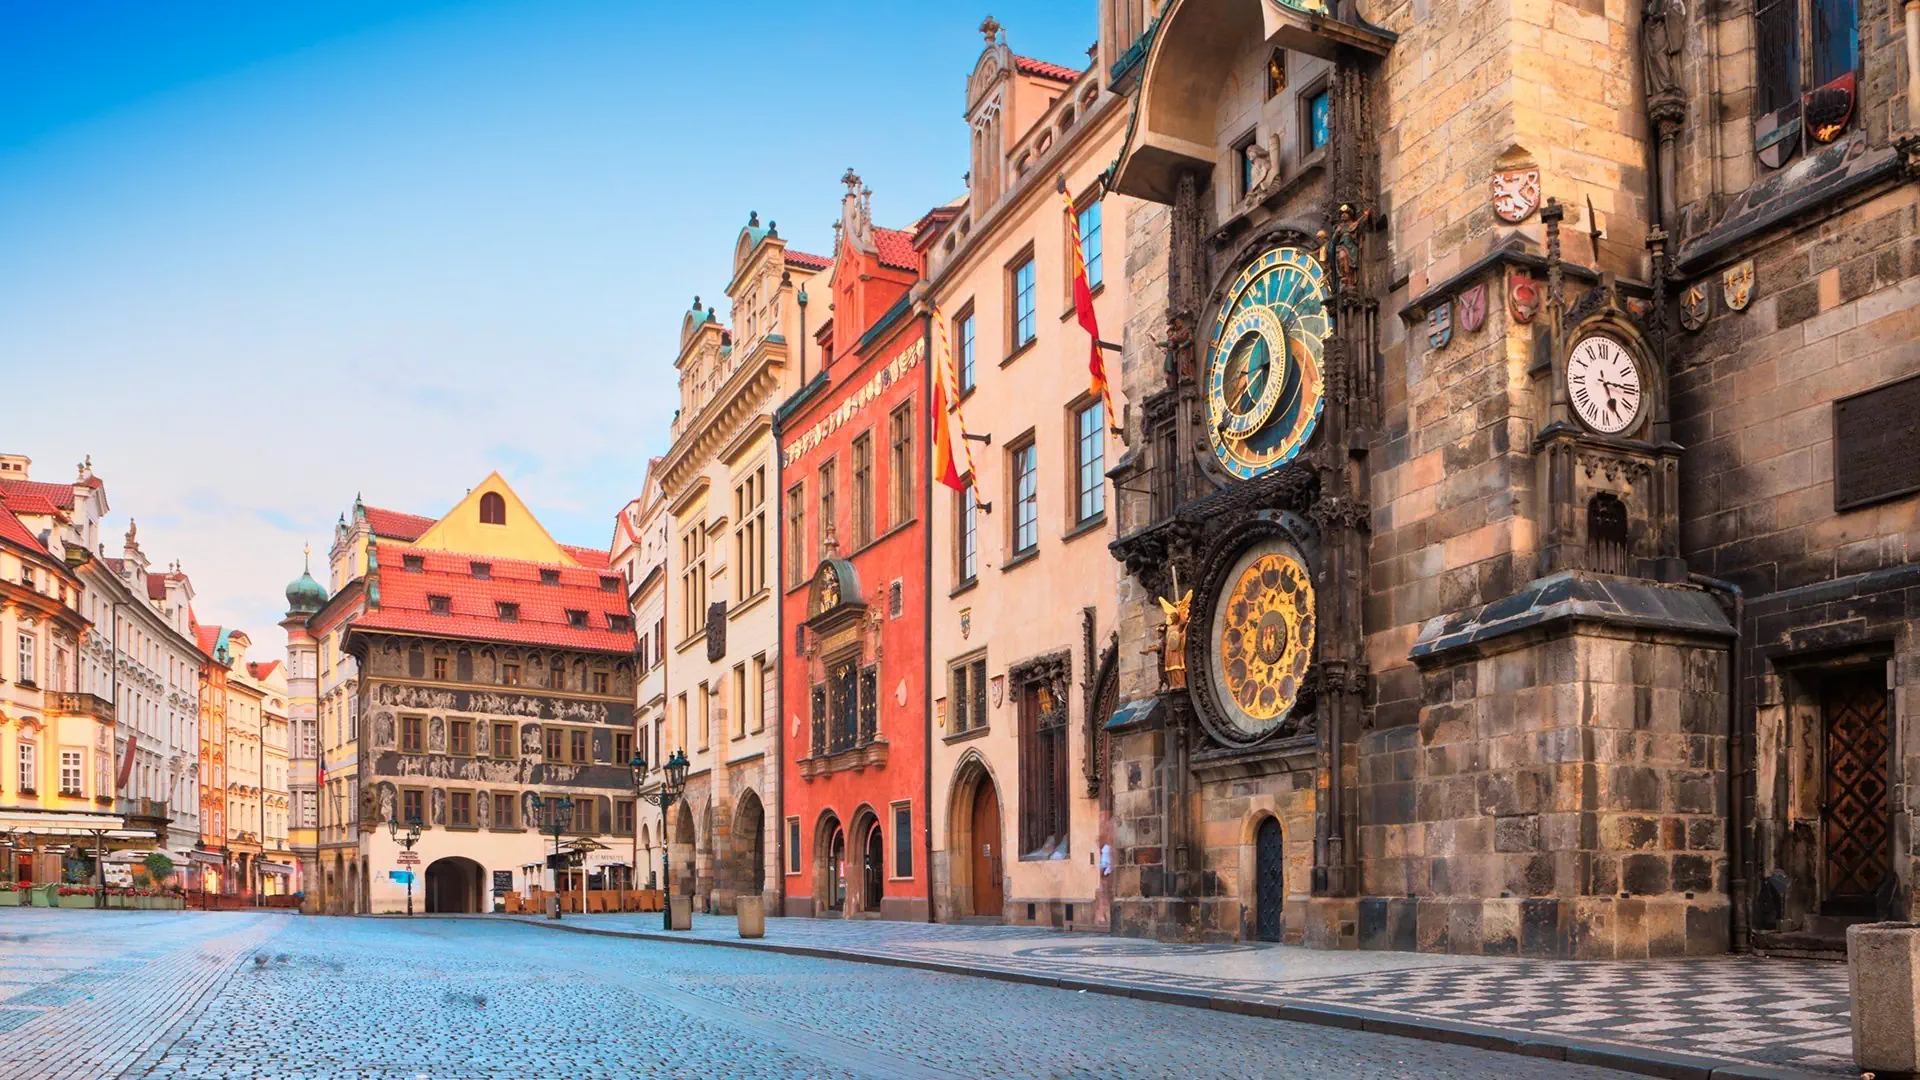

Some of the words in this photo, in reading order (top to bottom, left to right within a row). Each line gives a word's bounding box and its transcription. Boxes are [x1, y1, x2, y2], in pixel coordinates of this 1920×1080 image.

[1585, 345, 1596, 361] XI
[1598, 343, 1609, 360] XII
[1613, 352, 1620, 365] I
[1620, 367, 1632, 377] II
[1623, 383, 1635, 395] III
